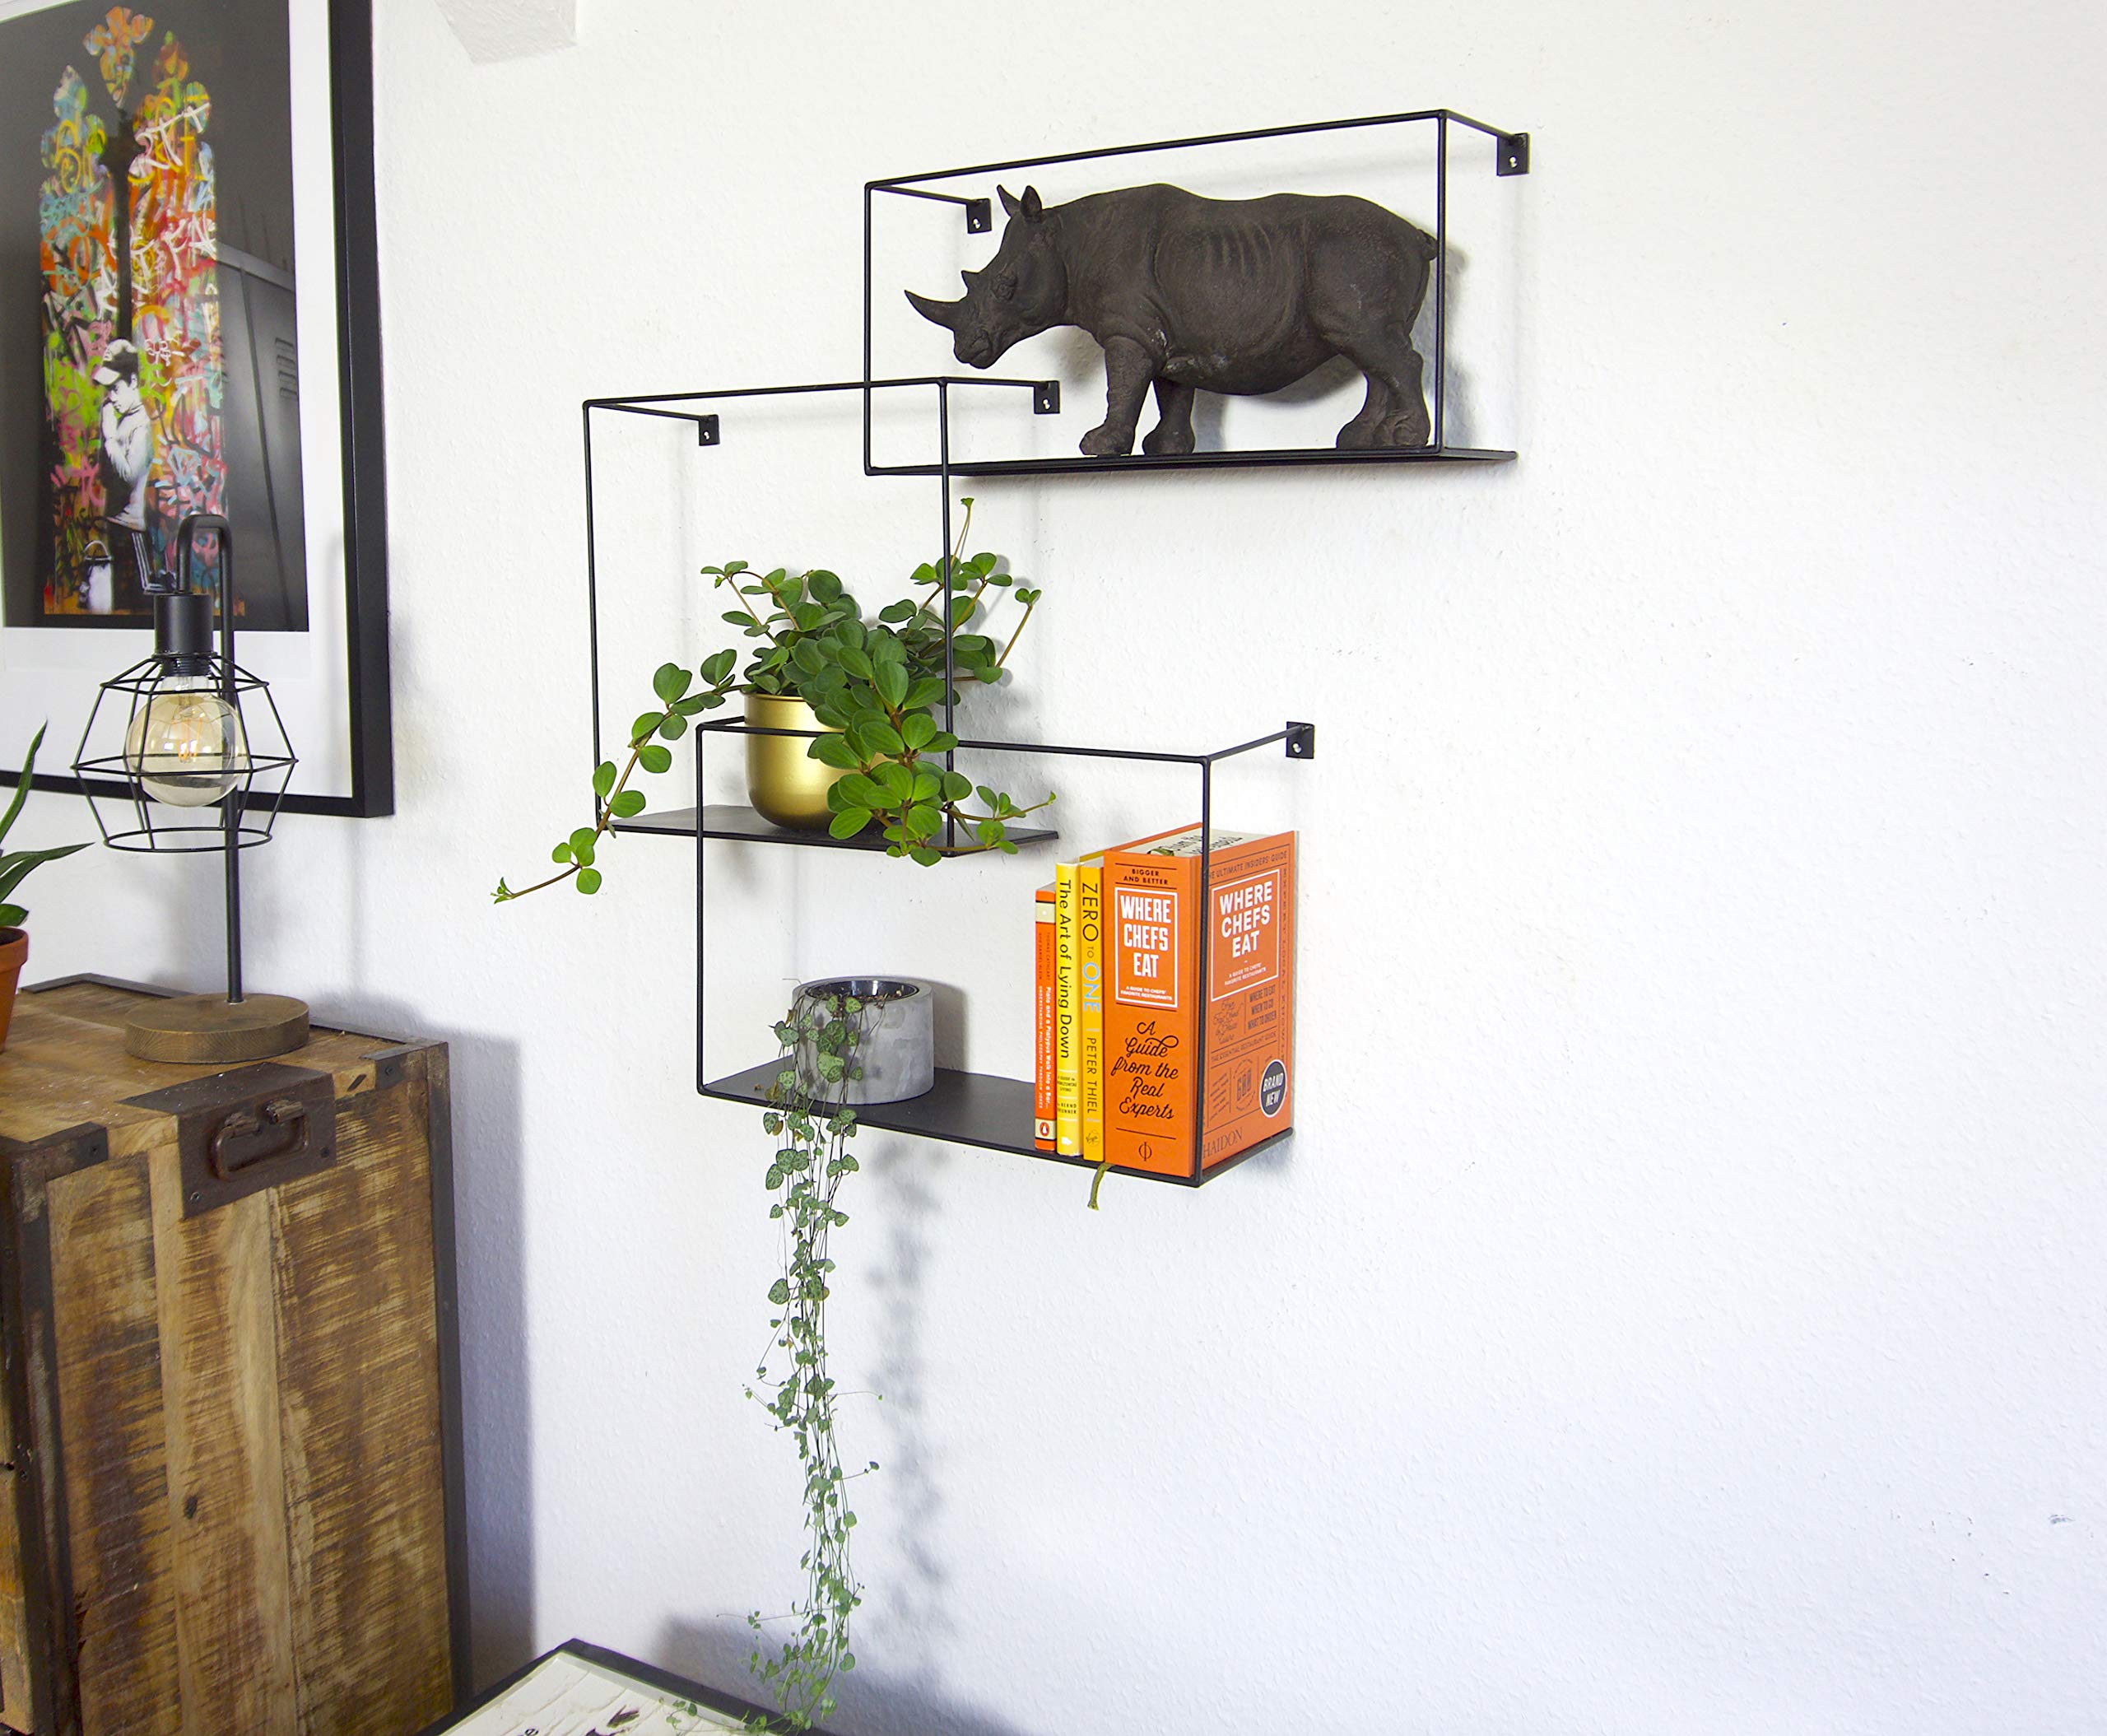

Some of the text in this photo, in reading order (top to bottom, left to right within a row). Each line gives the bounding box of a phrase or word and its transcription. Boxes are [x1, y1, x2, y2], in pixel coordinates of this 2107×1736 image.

[1131, 868, 1160, 877] BIGGER
[1216, 863, 1244, 877] ULTIMATE
[1120, 895, 1171, 924] WHERE
[1220, 881, 1272, 915] WHERE
[1221, 905, 1270, 938] CHEFS
[1082, 882, 1100, 1012] ZERO TO ONE
[1123, 924, 1169, 952] CHEFS
[1232, 930, 1260, 958] EAT
[1058, 879, 1072, 1059] The Art of Lying Down
[1133, 952, 1159, 978] EAT
[1137, 1021, 1156, 1036] A
[1125, 1035, 1179, 1058] Guide
[1086, 1037, 1098, 1114] PETER THIEL
[1110, 1056, 1179, 1080] from the
[1130, 1076, 1165, 1100] Real
[1263, 1073, 1284, 1092] BRAND
[1119, 1096, 1174, 1119] Experts
[1266, 1090, 1281, 1107] NEW
[1202, 1127, 1243, 1159] HAIDON
